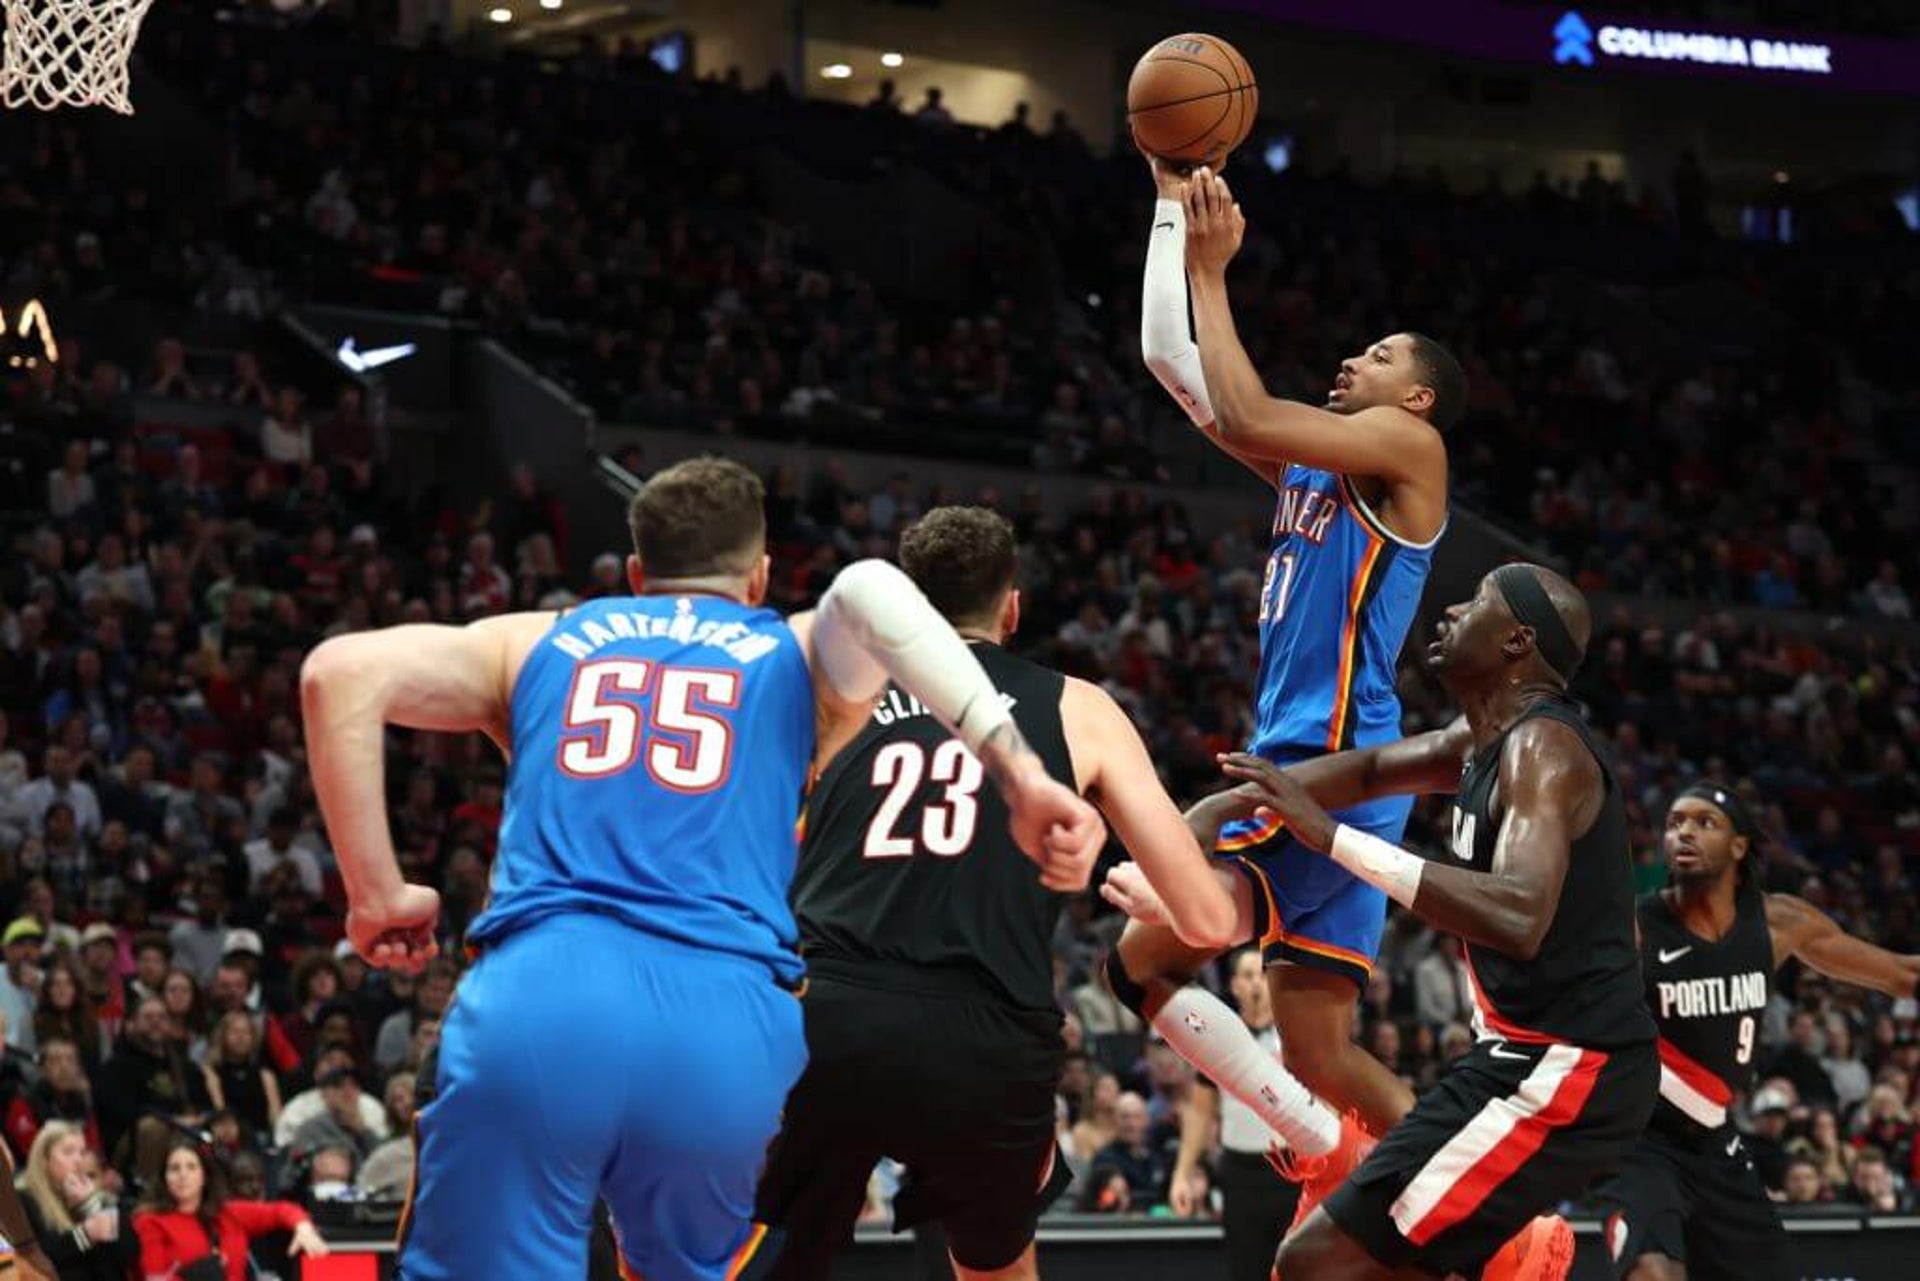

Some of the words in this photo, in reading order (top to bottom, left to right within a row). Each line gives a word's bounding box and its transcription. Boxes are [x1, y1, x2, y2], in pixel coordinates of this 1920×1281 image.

[1598, 26, 1748, 66] COLUMBIA
[1750, 39, 1831, 73] BANK
[556, 655, 742, 795] 55
[862, 738, 984, 859] 23
[1657, 971, 1767, 1019] PORTLAND
[1736, 1015, 1755, 1064] 9
